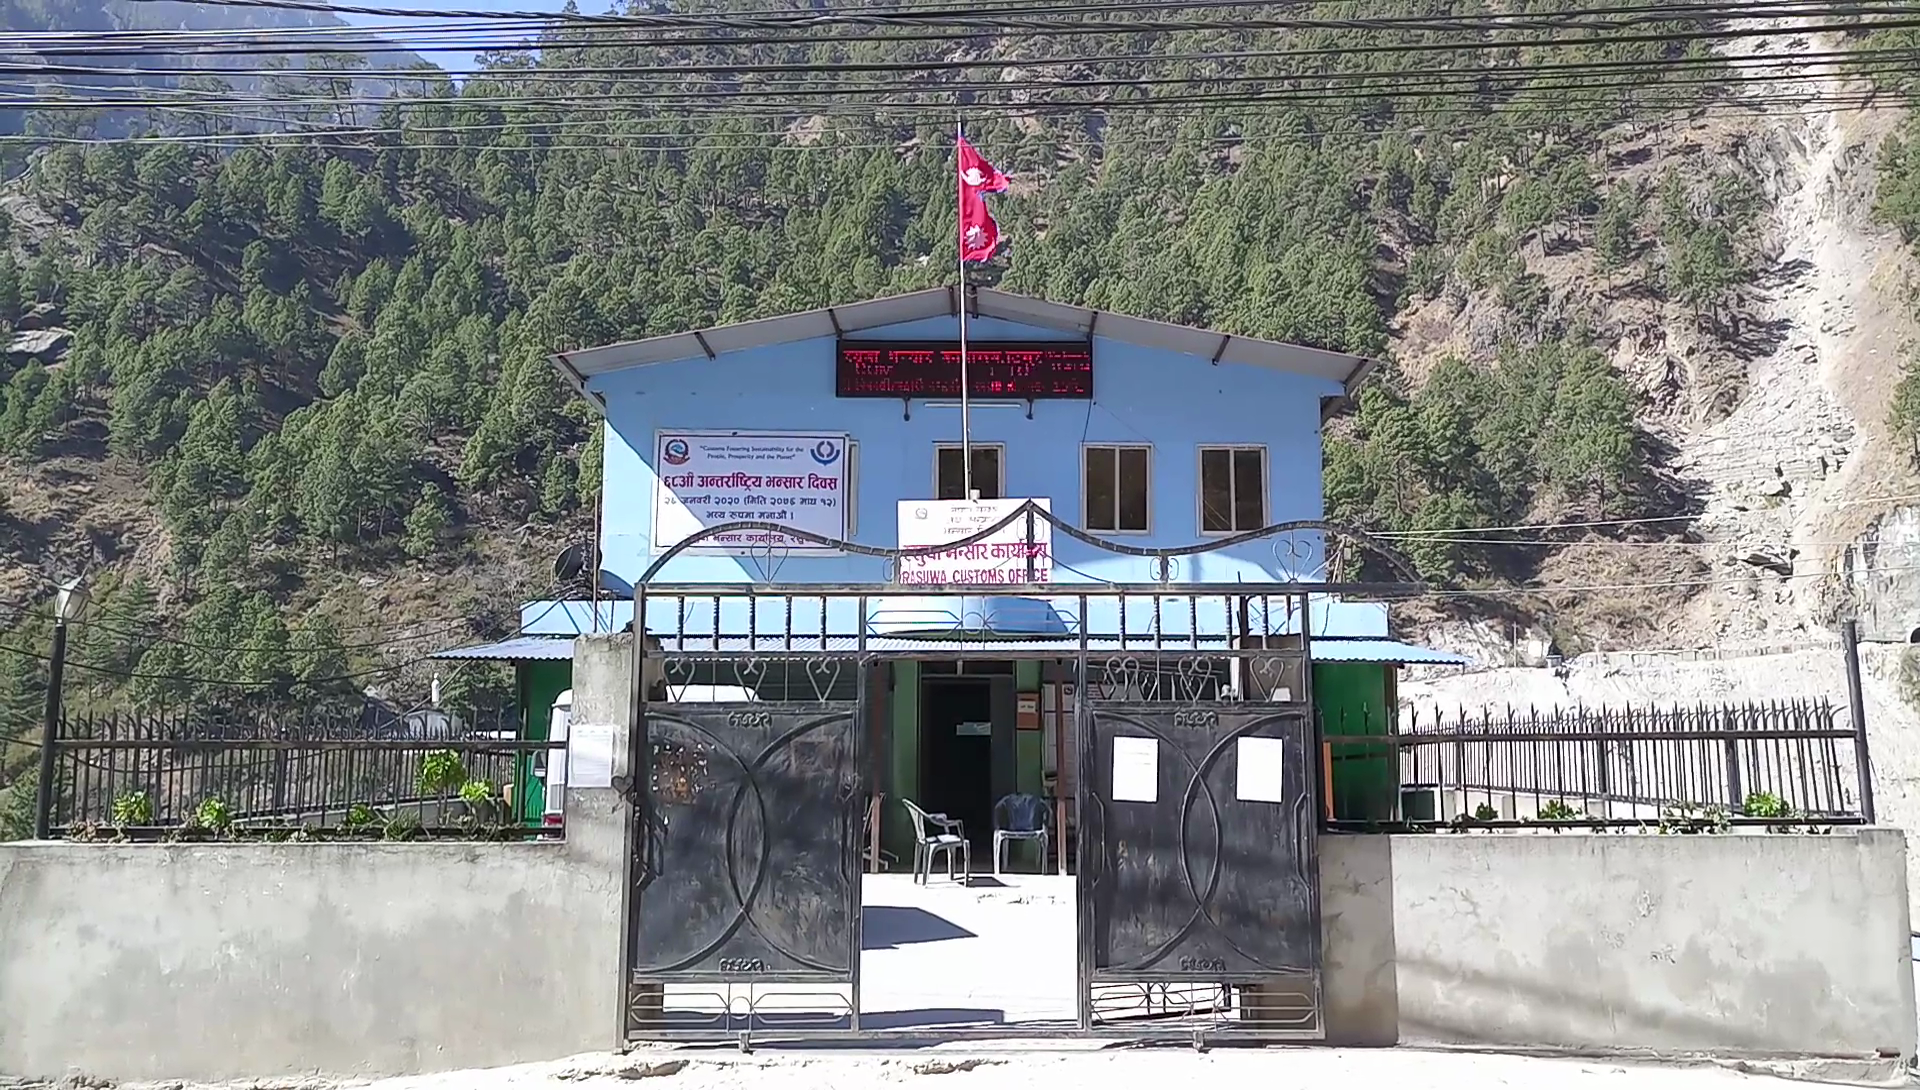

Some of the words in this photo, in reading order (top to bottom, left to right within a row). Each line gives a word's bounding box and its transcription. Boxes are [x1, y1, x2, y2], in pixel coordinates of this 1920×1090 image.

[765, 475, 806, 490] भन्सार
[808, 473, 839, 491] दिवस
[714, 496, 740, 505] २०२०
[743, 494, 767, 506] (मिति
[769, 497, 796, 506] २०७६
[820, 497, 837, 507] १२)
[902, 569, 947, 584] RASUWA
[952, 568, 1005, 584] CUSTOMS
[1008, 568, 1048, 583] OFFCE
